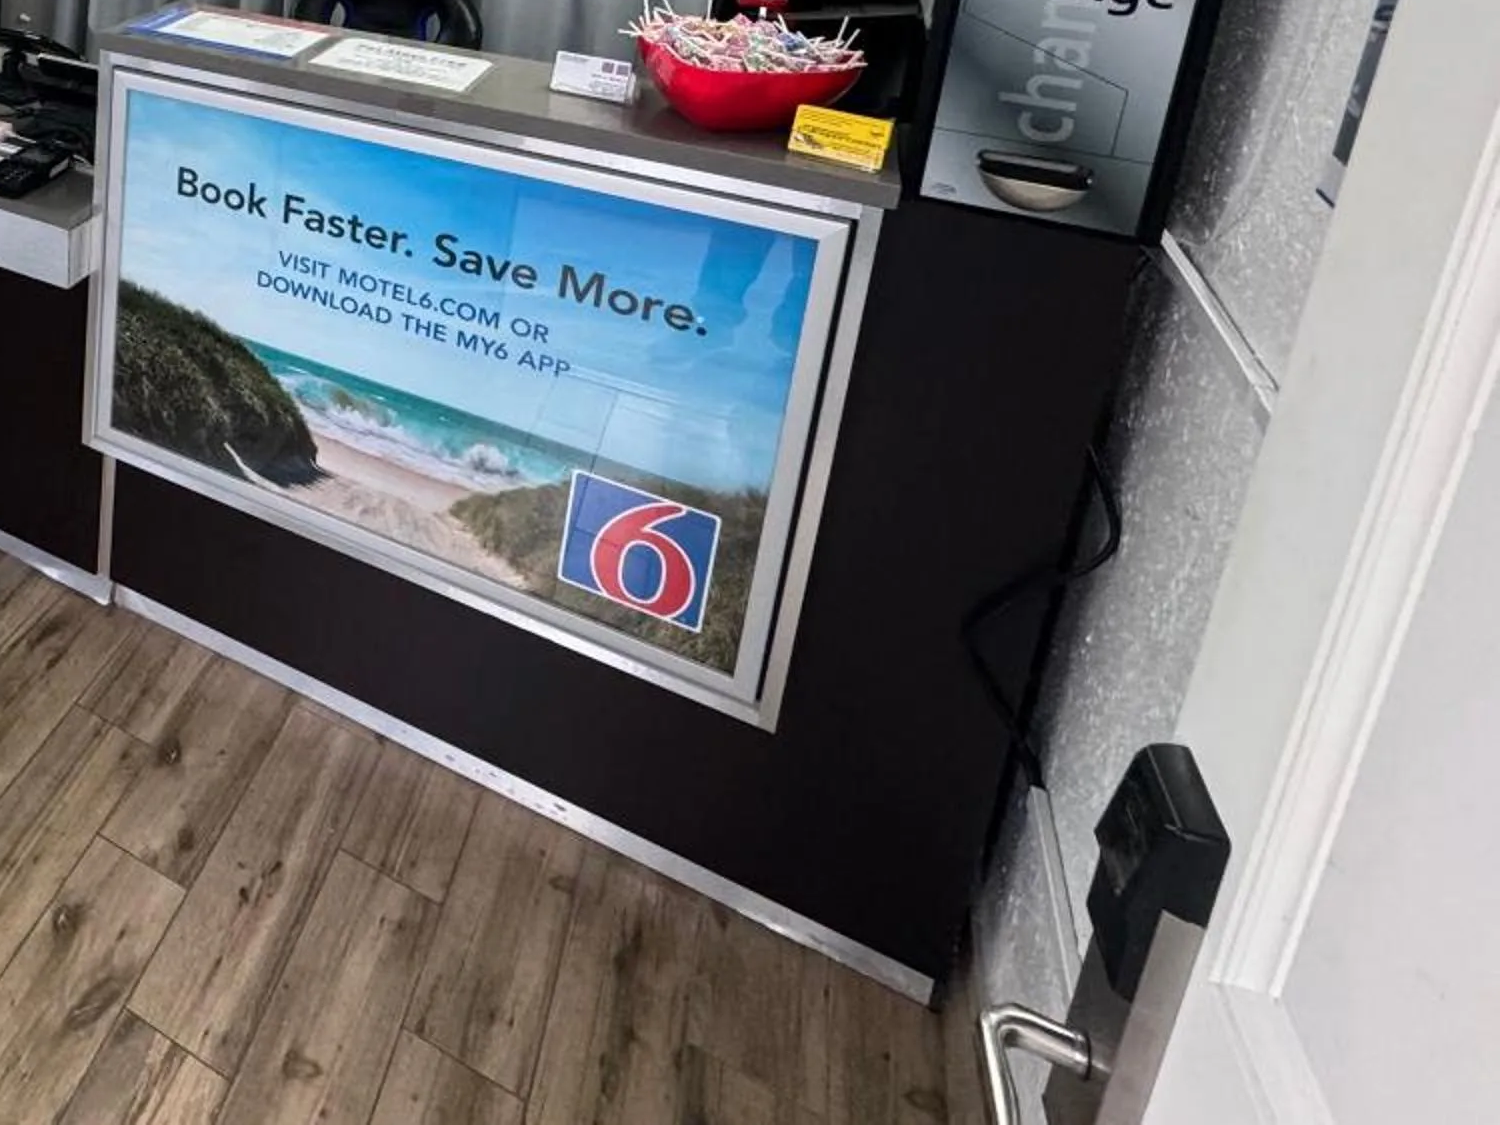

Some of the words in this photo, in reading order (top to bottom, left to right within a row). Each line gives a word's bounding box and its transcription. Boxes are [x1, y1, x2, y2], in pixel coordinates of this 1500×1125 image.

[177, 166, 267, 218] Book
[283, 194, 413, 257] Faster.
[433, 233, 538, 289] Save
[558, 264, 707, 336] More.
[279, 250, 331, 280] VISIT
[338, 267, 500, 330] MOTEL6.COM
[510, 317, 549, 344] OR
[257, 271, 392, 324] DOWNLOAD
[401, 313, 447, 343] THE
[457, 330, 508, 361] MY6
[517, 350, 572, 377] APP
[590, 501, 695, 620] 6
